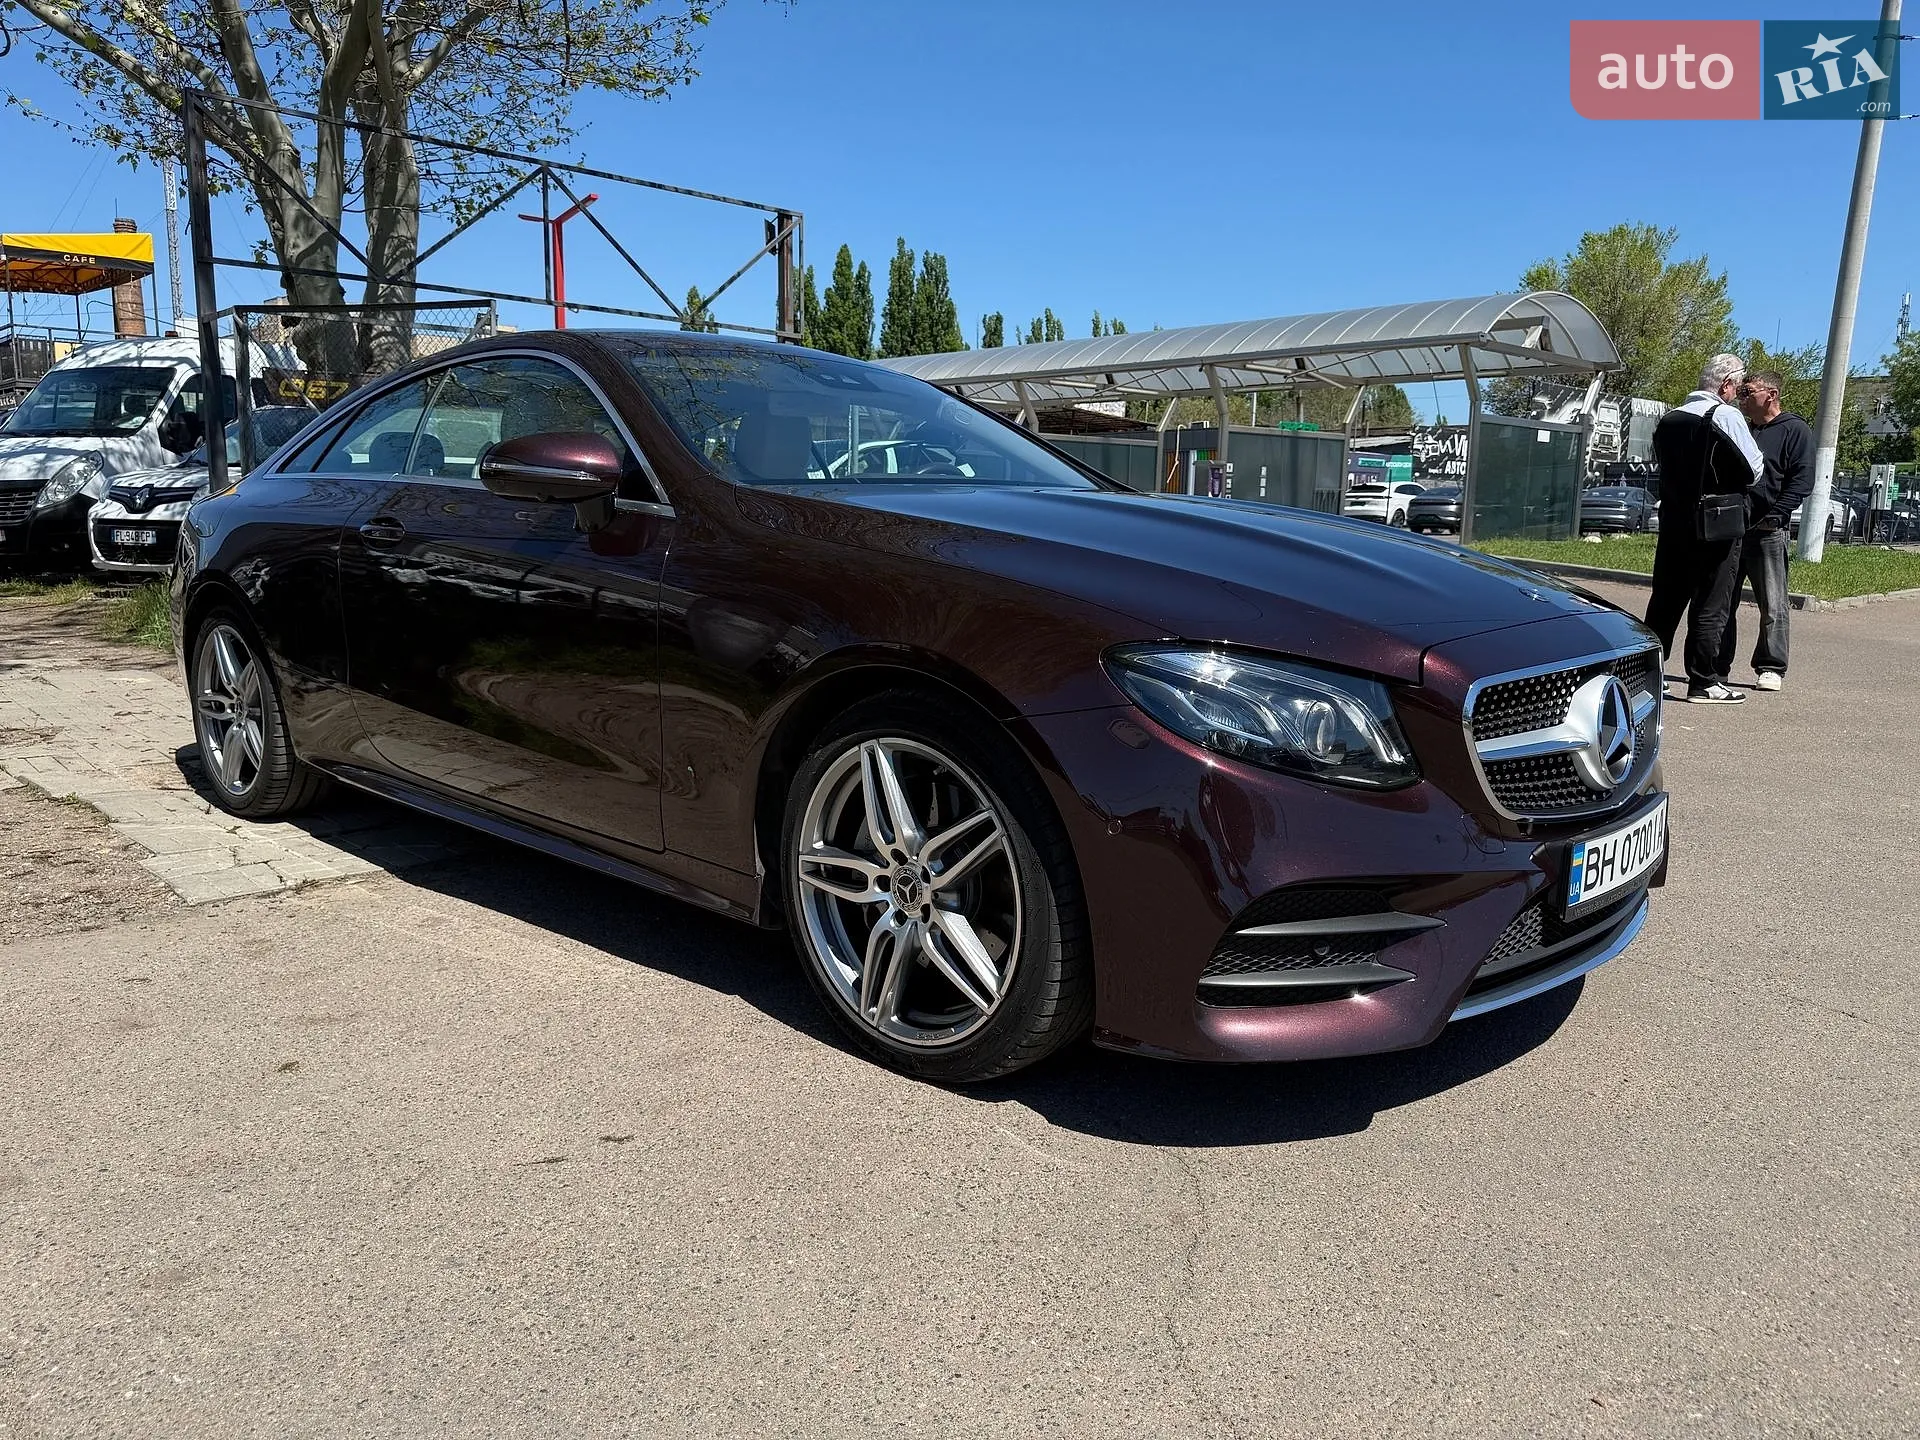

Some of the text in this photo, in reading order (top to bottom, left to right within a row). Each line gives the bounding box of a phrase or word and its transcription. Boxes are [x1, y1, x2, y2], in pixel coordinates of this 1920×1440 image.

[63, 254, 96, 265] CAFE
[1583, 838, 1618, 893] BH
[1620, 819, 1653, 877] 0700
[1569, 881, 1580, 897] UA
